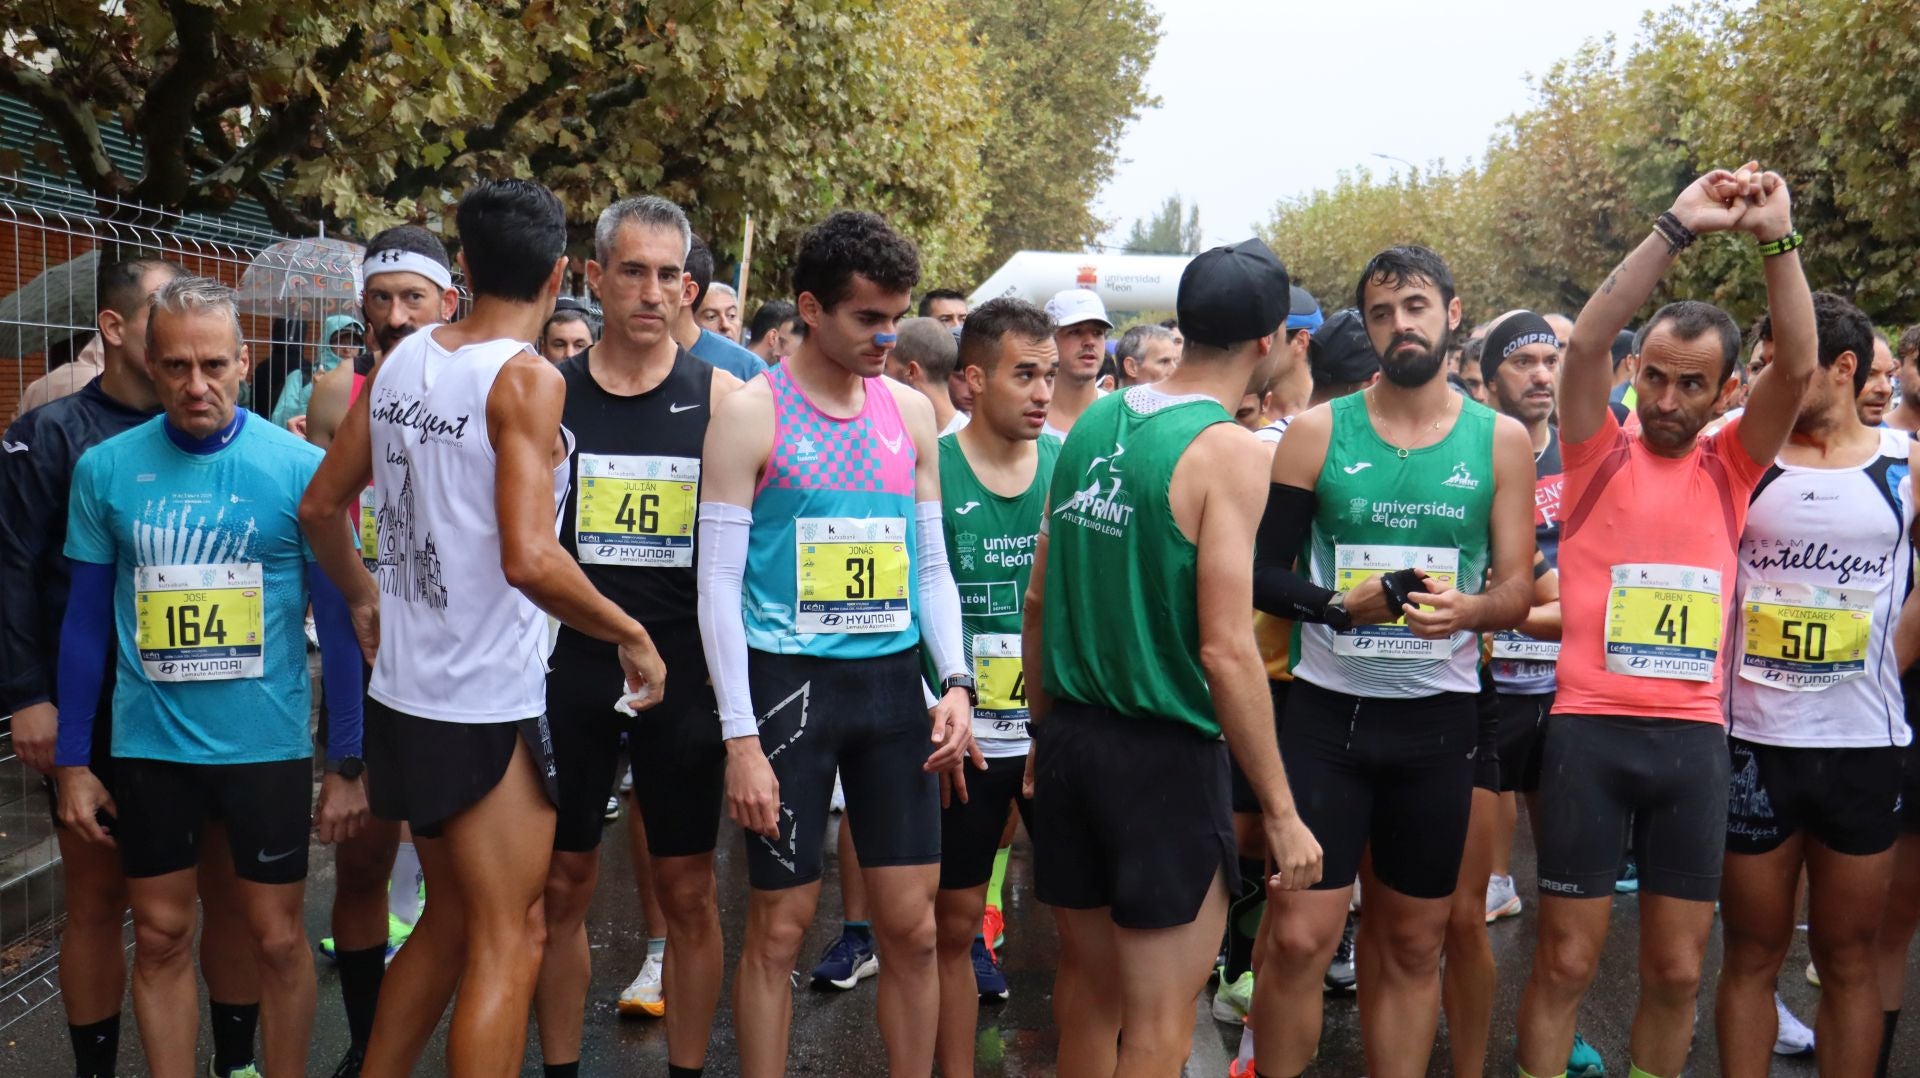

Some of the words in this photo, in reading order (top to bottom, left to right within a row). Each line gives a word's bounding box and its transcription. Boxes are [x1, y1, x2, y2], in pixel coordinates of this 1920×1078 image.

[1104, 274, 1160, 284] universidad
[382, 388, 412, 402] TEAM
[373, 399, 469, 444] intelligent
[623, 481, 657, 491] JULIÁN
[615, 493, 660, 533] 46
[1071, 491, 1134, 527] SPRINT
[1372, 500, 1465, 520] universidad
[1061, 512, 1101, 531] ATLETISMO
[1371, 512, 1385, 522] de
[1385, 512, 1417, 528] león
[1749, 539, 1804, 548] TEAM
[620, 548, 675, 559] HYUNDAI
[848, 546, 874, 555] JONÁS
[984, 551, 999, 563] de
[1749, 543, 1887, 584] intelligent
[846, 558, 874, 598] 31
[184, 592, 207, 602] JOSE
[961, 593, 986, 603] LEÓN
[166, 604, 228, 648] 164
[846, 614, 895, 625] HYUNDAI
[1654, 604, 1688, 644] 41
[1377, 640, 1432, 650] HYUNDAI
[1782, 620, 1827, 661] 50
[181, 660, 242, 673] HYUNDAI
[1654, 660, 1709, 673] HYUNDAI
